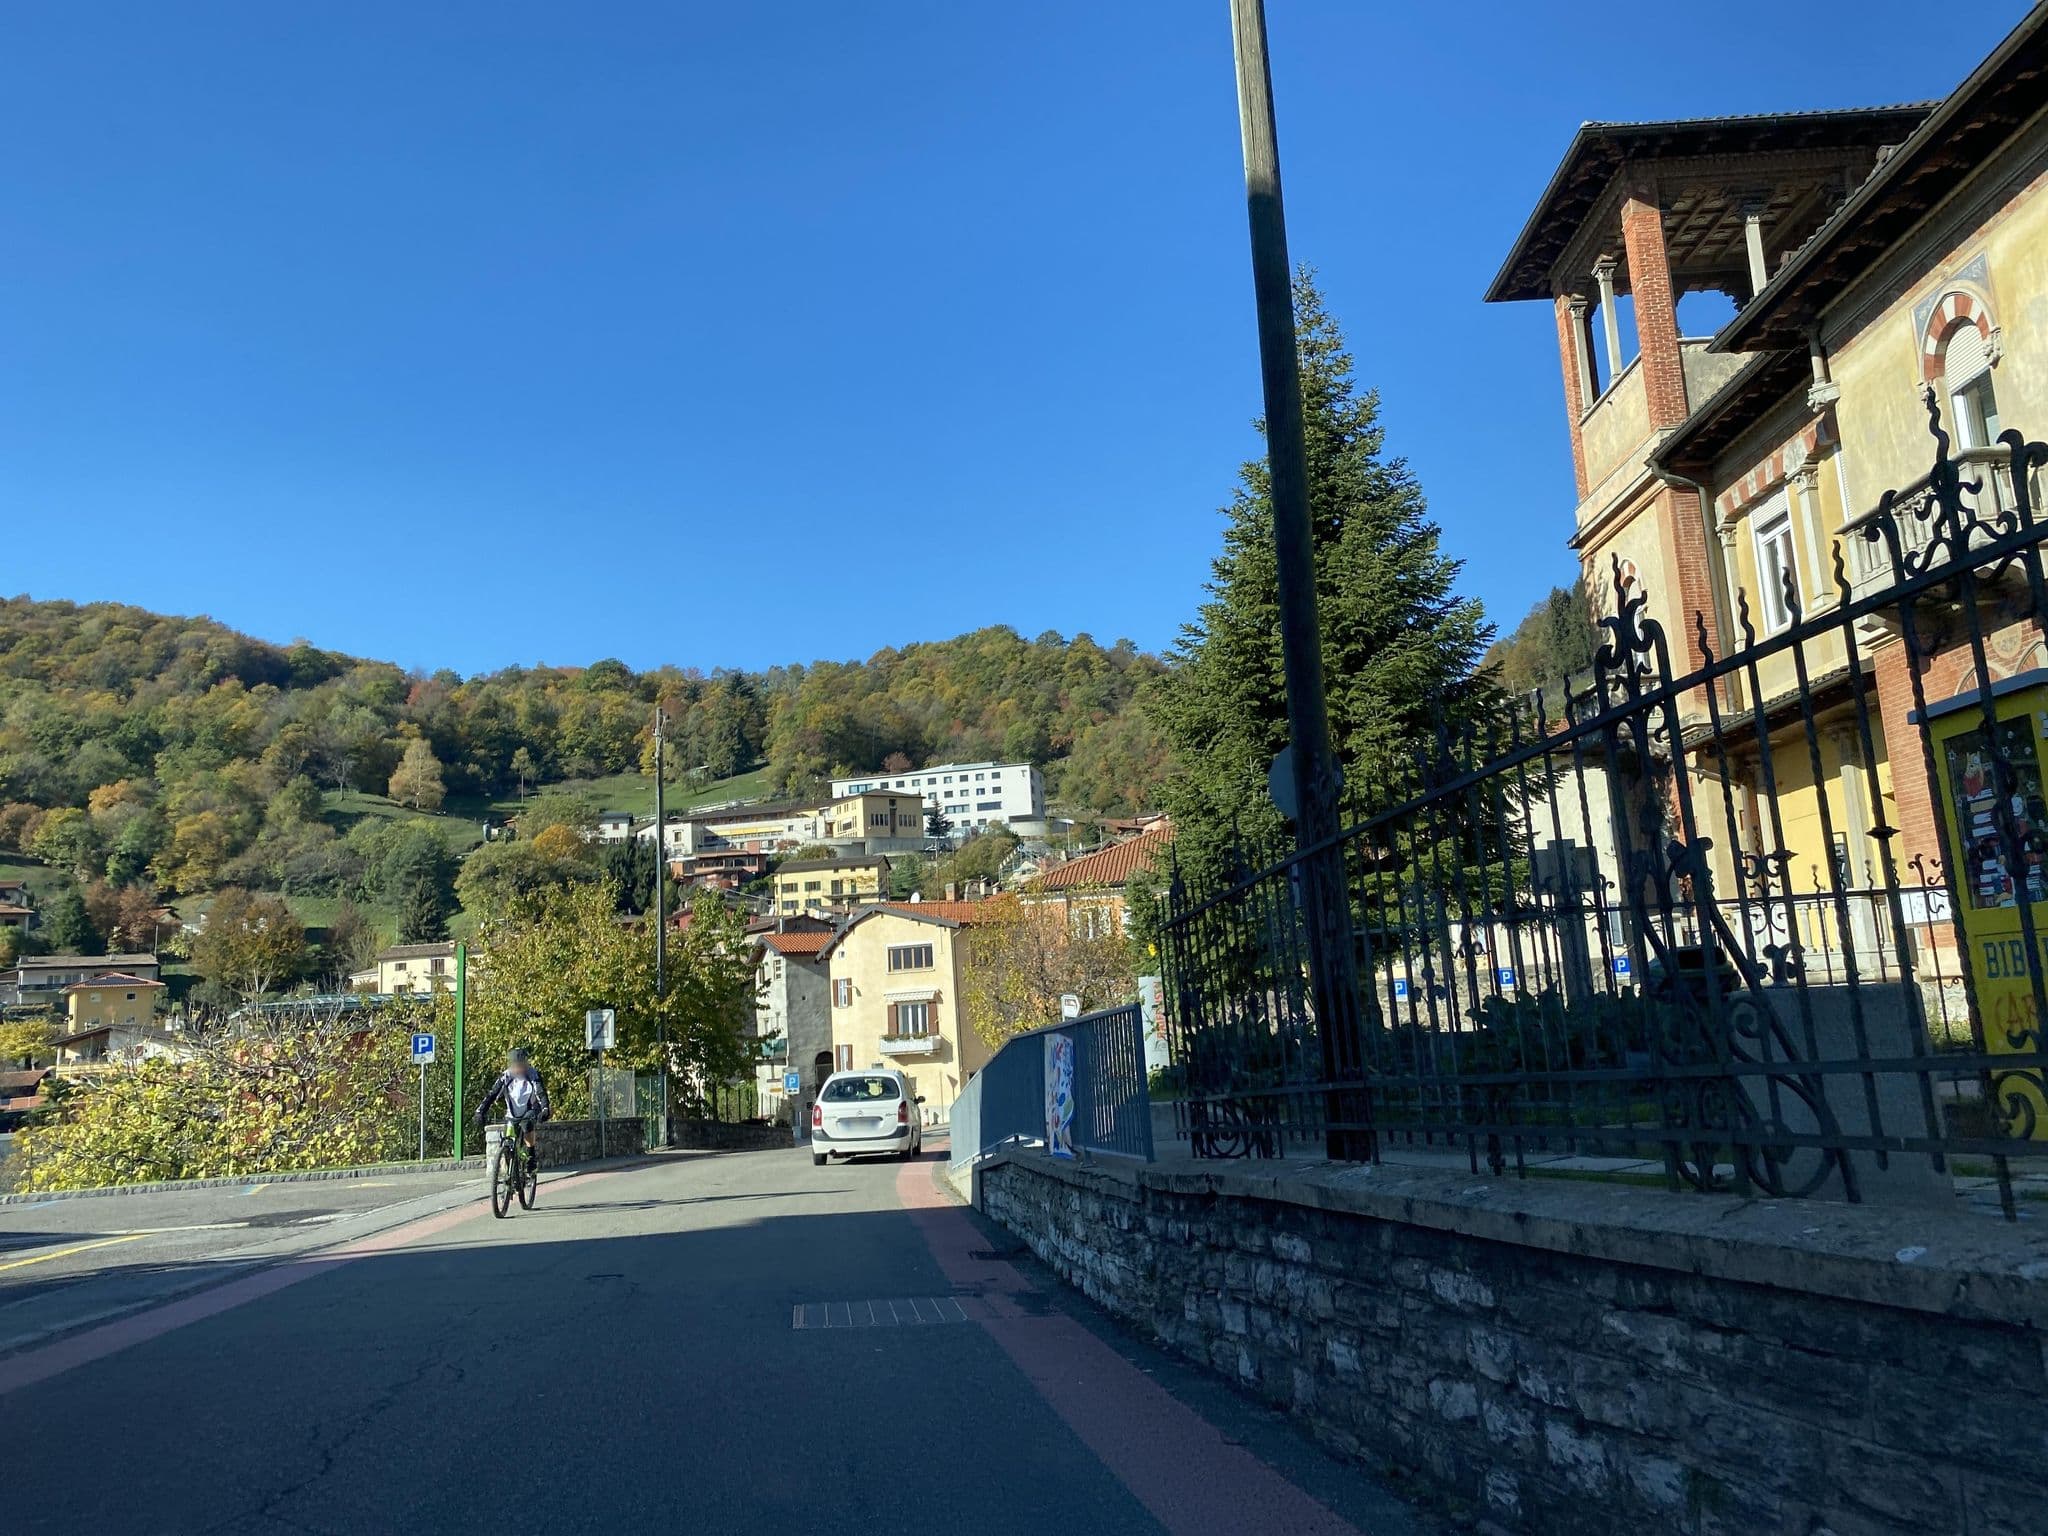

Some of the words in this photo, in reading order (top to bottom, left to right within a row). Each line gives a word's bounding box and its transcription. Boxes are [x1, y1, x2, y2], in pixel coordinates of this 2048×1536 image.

[1617, 960, 1626, 972] P
[1502, 971, 1511, 983] P
[1395, 982, 1403, 994] P
[418, 1037, 428, 1053] P
[789, 1077, 796, 1087] P
